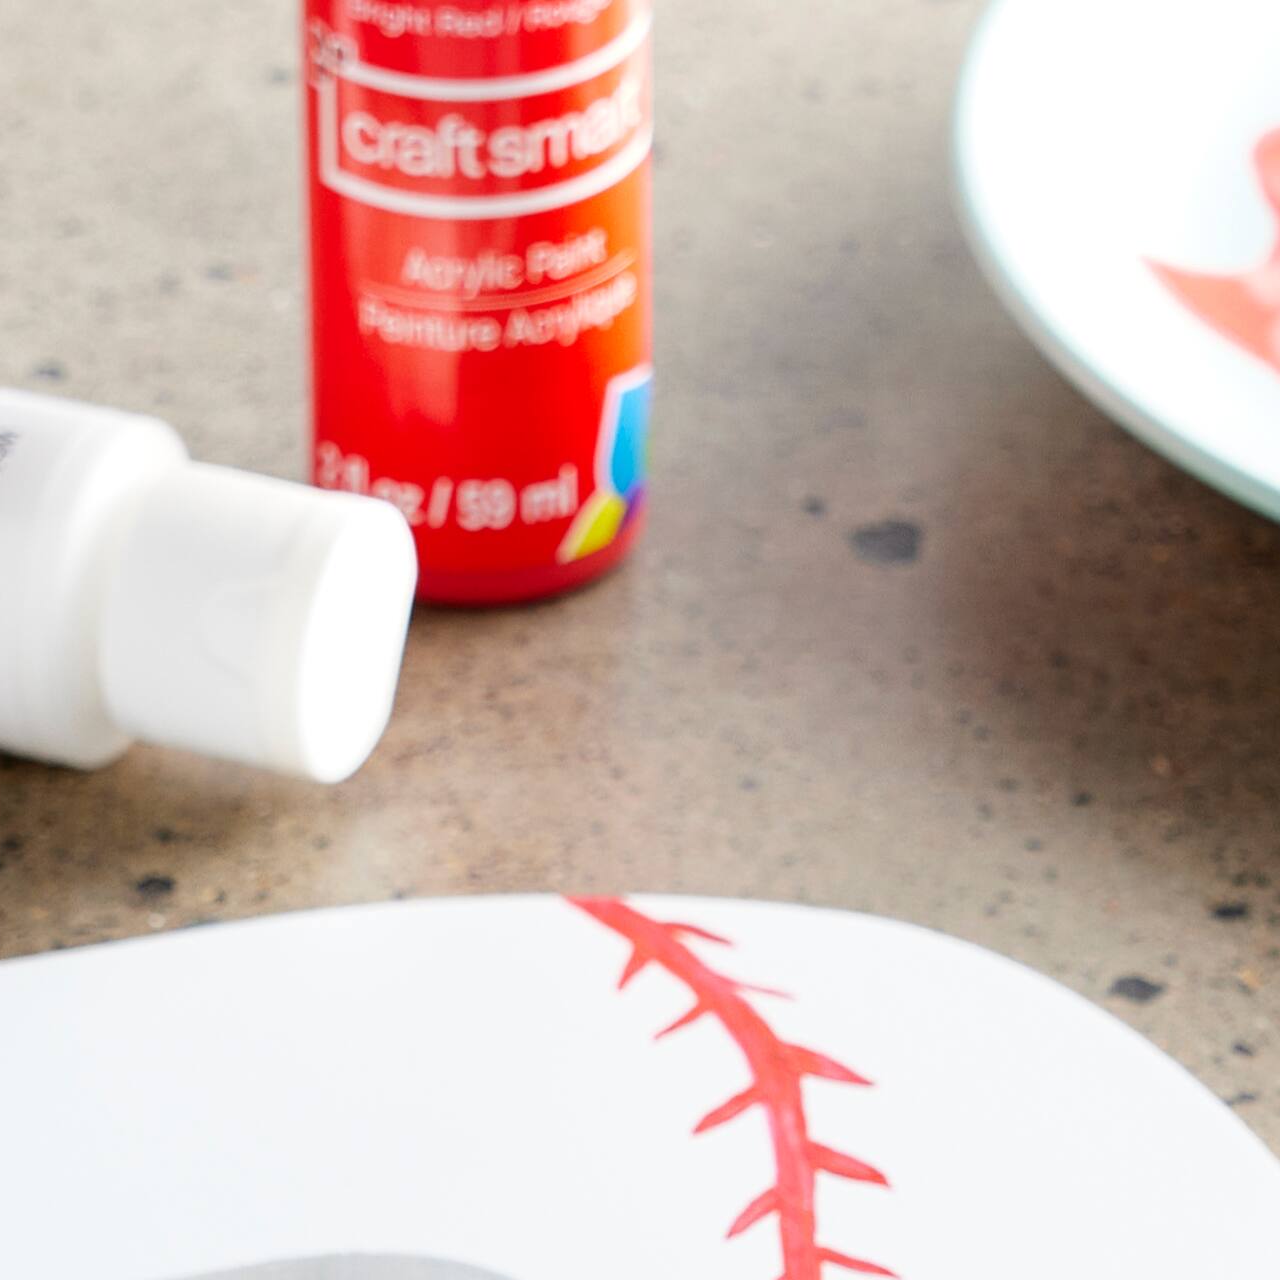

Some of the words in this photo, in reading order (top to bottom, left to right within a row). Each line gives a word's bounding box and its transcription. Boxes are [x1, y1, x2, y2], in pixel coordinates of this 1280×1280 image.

[342, 109, 487, 178] craft
[401, 246, 525, 299] Acrylic
[525, 228, 607, 283] Paint
[358, 298, 501, 351] Peinture
[503, 271, 637, 347] Acrylique
[455, 478, 517, 530] 59
[521, 462, 578, 524] ml
